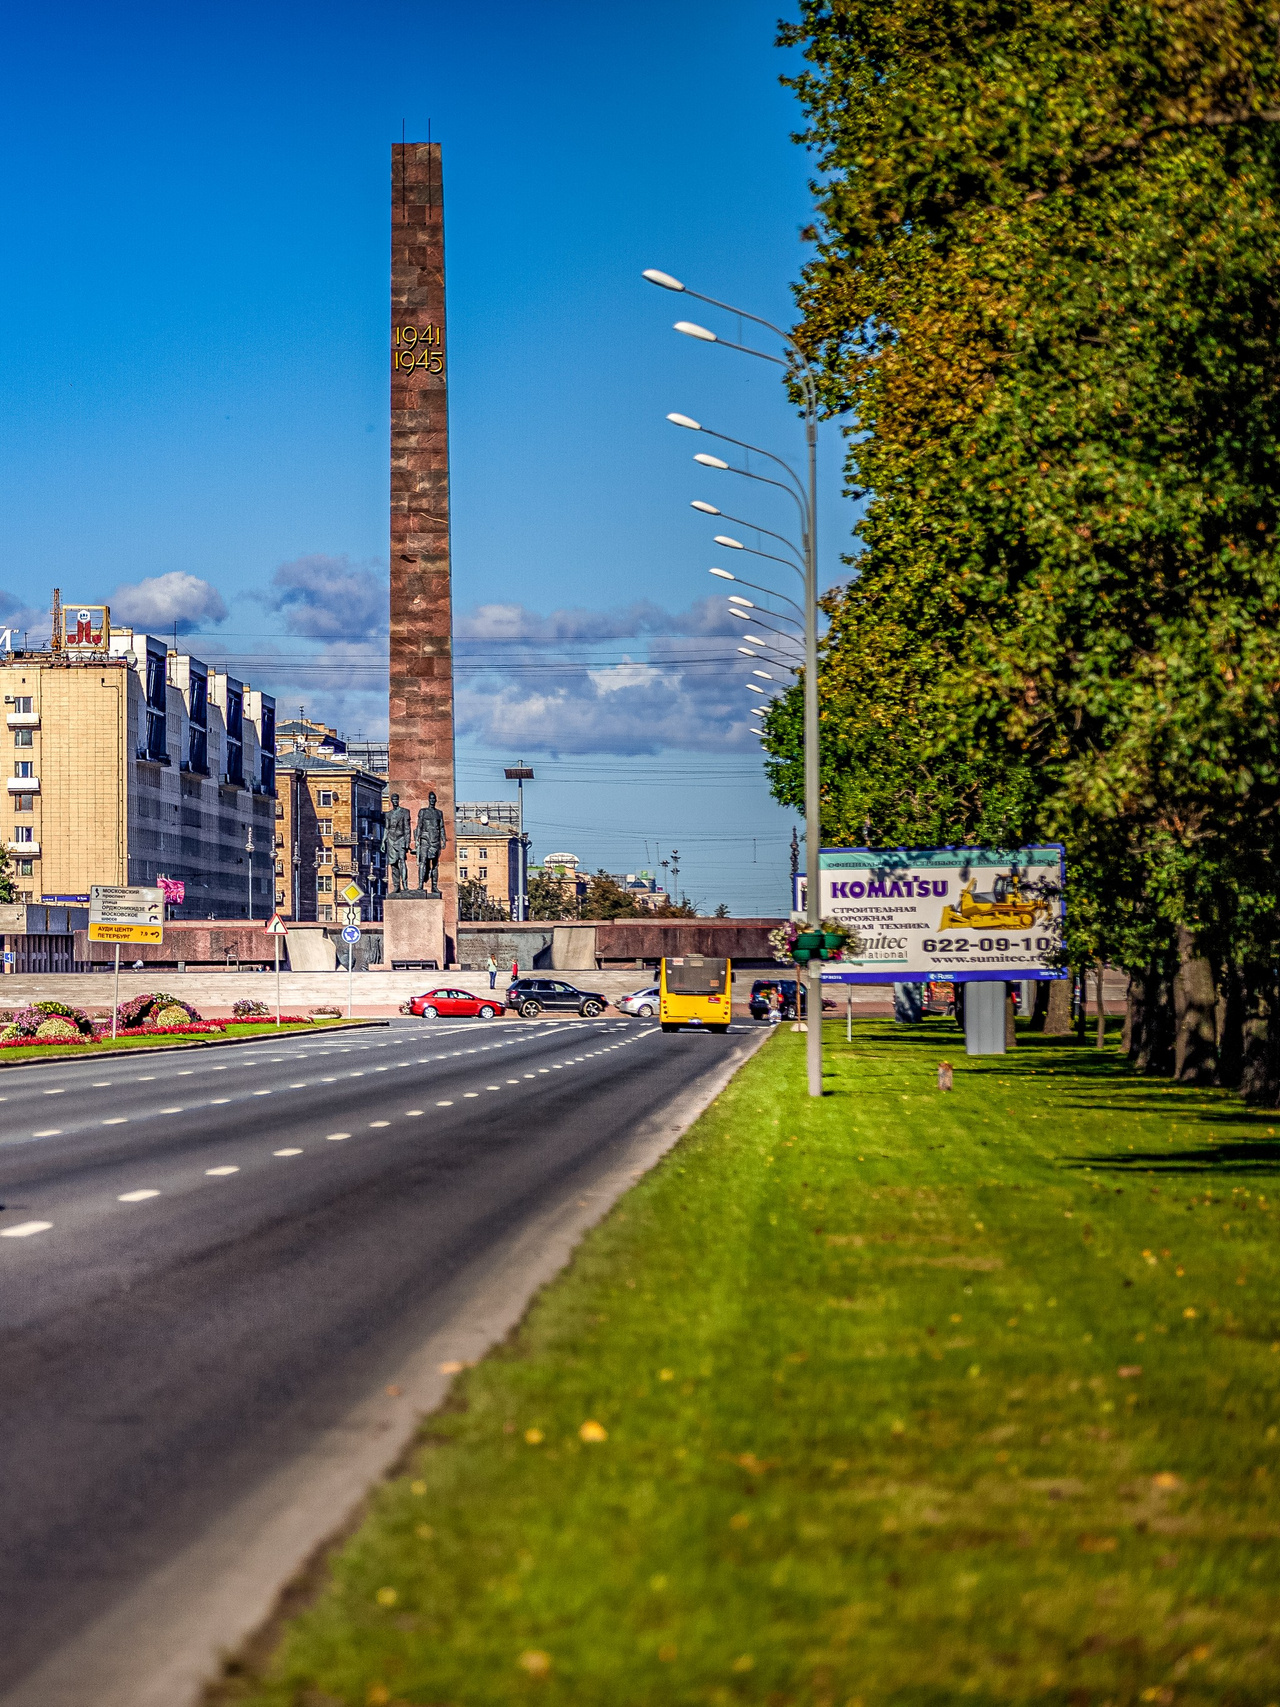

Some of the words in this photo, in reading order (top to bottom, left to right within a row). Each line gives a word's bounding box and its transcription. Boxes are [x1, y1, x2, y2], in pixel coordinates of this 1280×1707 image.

[396, 323, 440, 350] 1941
[395, 349, 443, 375] 1945
[831, 875, 949, 899] KOMATSU
[832, 906, 917, 914] СТРОИТЕЛЬНАЯ
[861, 932, 908, 950] mitec
[923, 937, 1051, 953] 622-09-10
